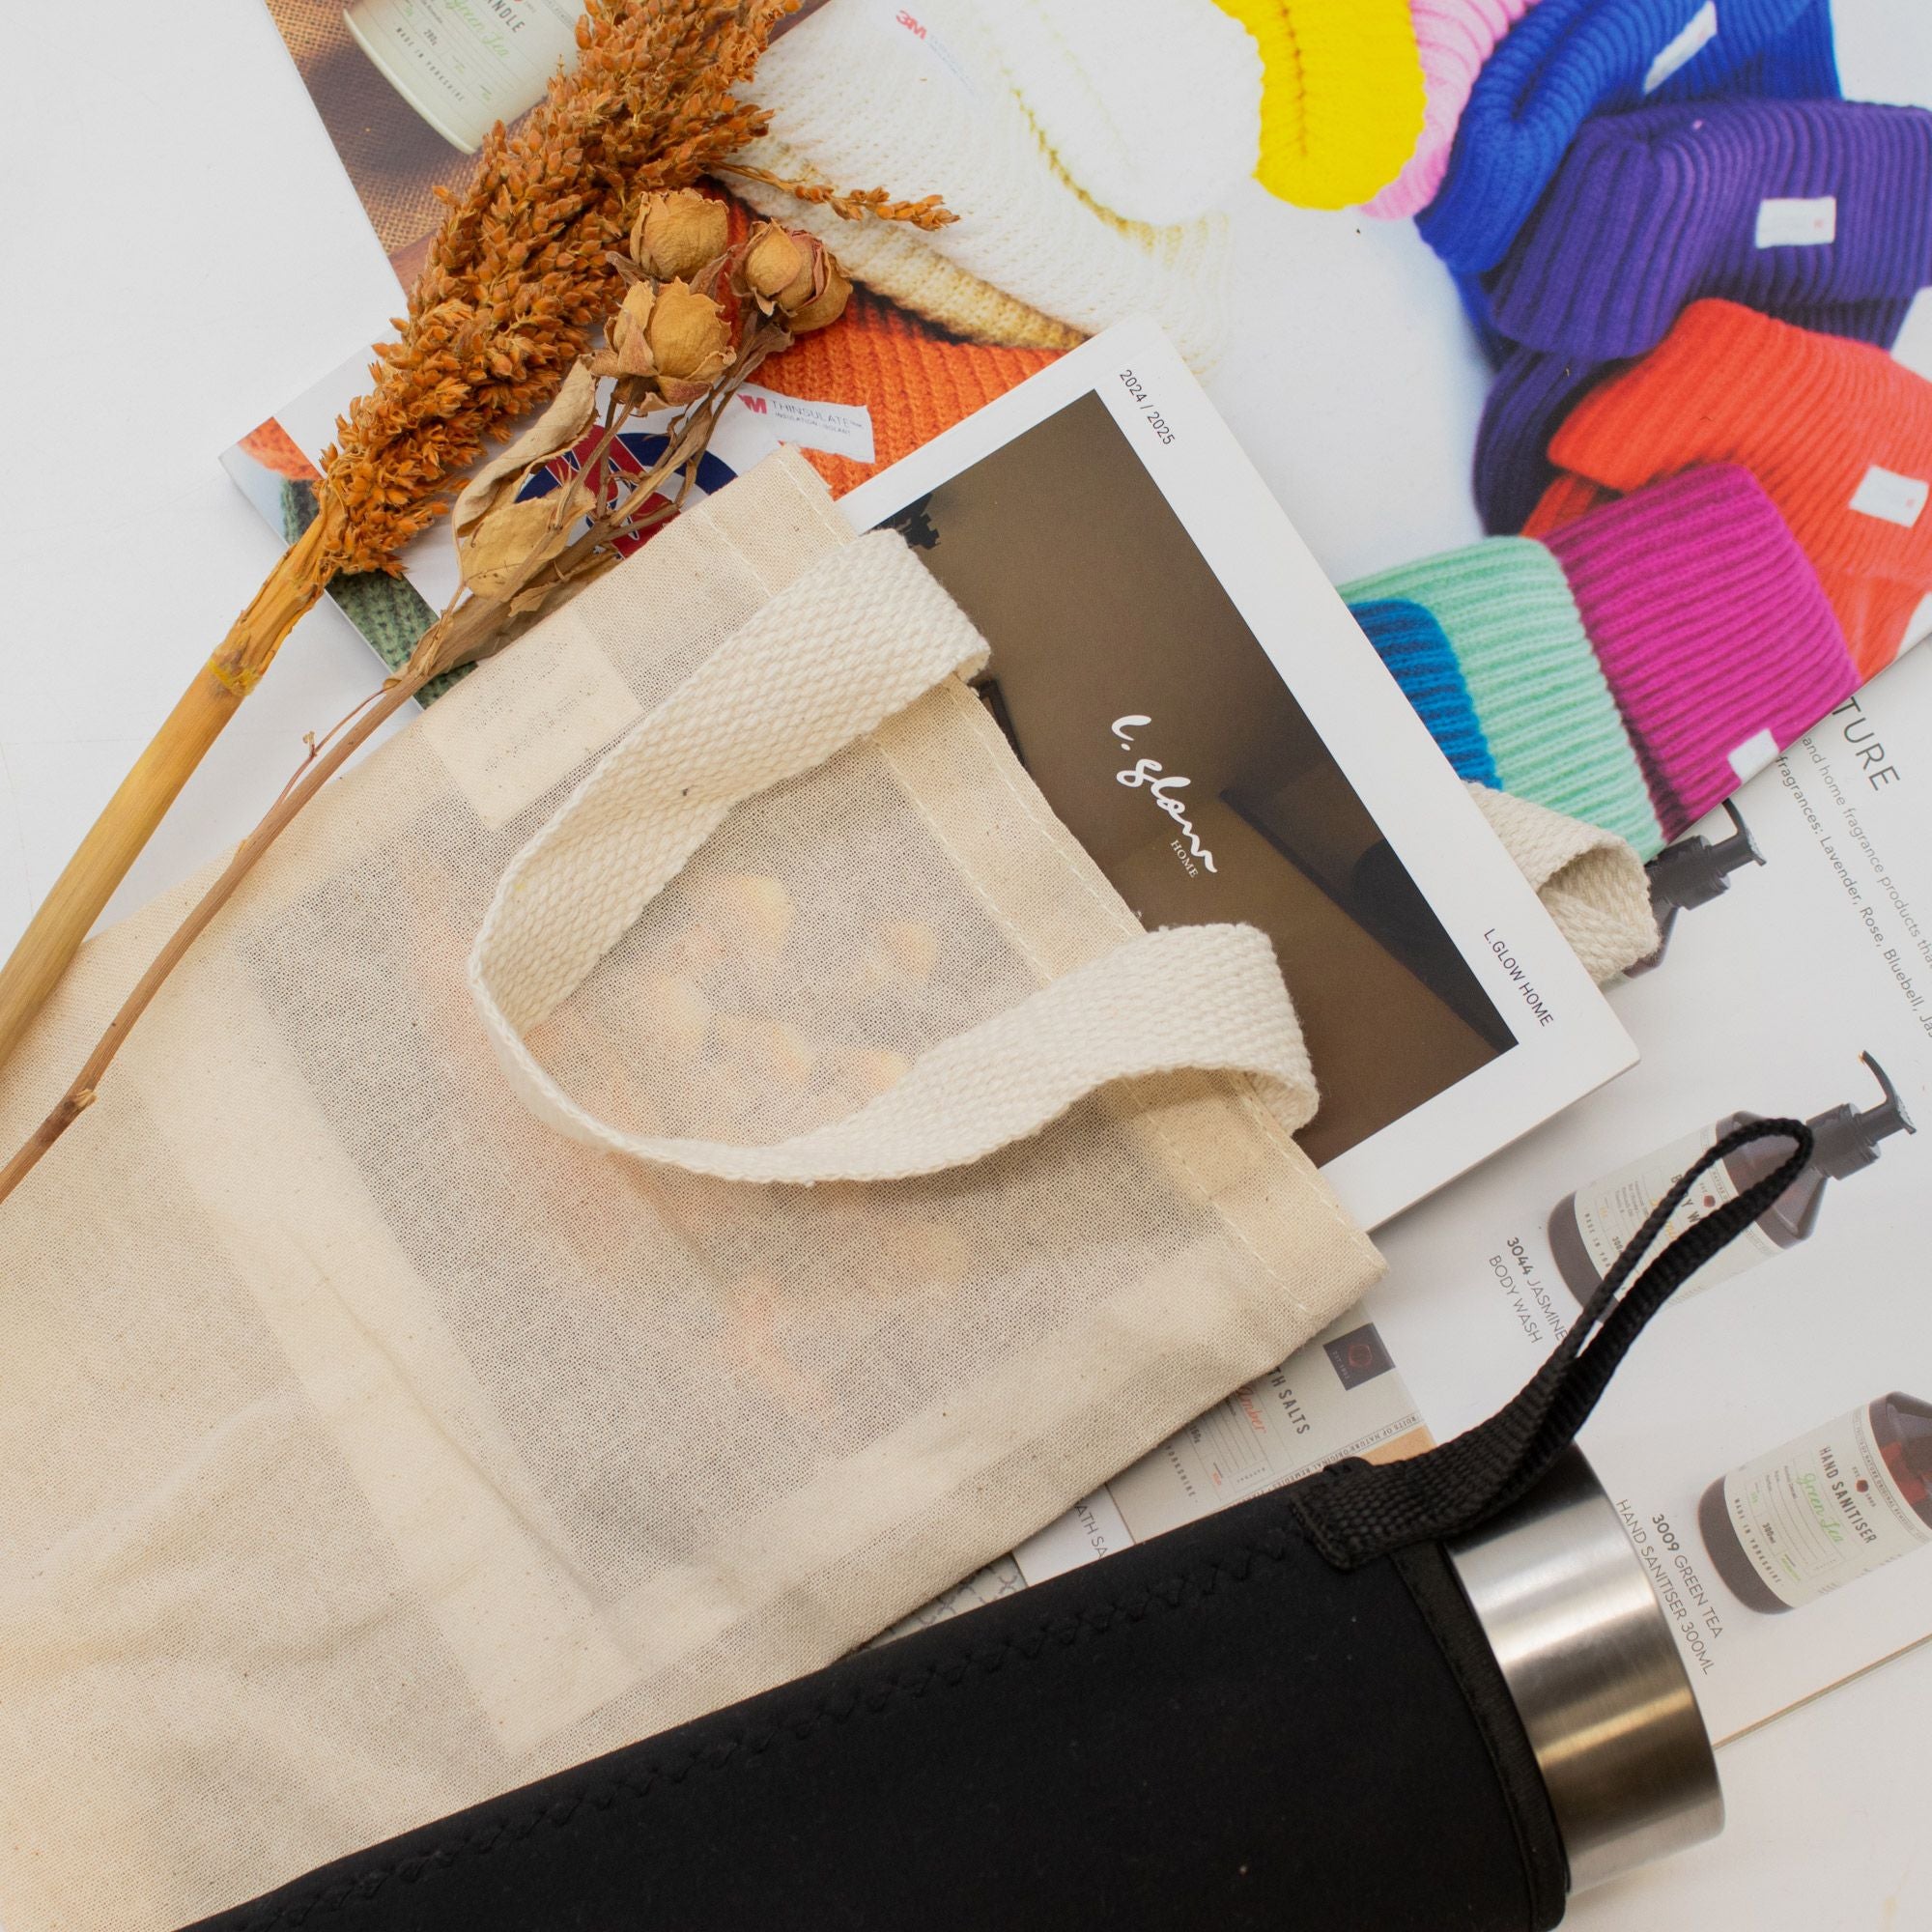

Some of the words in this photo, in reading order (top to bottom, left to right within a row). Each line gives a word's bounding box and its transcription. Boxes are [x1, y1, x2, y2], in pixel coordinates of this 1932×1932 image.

[486, 0, 525, 33] NDLE
[1120, 369, 1148, 403] 2024
[1147, 411, 1175, 445] 2025
[1170, 839, 1199, 878] HOME
[1774, 753, 1825, 835] fragrances:
[1819, 836, 1861, 903] Lavender,
[1860, 905, 1886, 947] Rose,
[1883, 948, 1924, 1011] Bluebell,
[1801, 736, 1825, 764] and
[1817, 763, 1845, 807] home
[1842, 806, 1885, 873] fragrance
[1877, 874, 1921, 938] products
[1917, 939, 1932, 969] tha
[1484, 928, 1525, 981] L.GLOW
[1519, 982, 1553, 1027] HOME
[1489, 1254, 1519, 1294] BODY
[1512, 1297, 1542, 1342] WASH
[1506, 1236, 1534, 1275] 3044
[1526, 1276, 1568, 1340] JASMINE
[1277, 1388, 1310, 1435] SALTS
[1072, 1502, 1096, 1534] ATH
[1798, 1472, 1825, 1515] Green
[1819, 1518, 1844, 1544] Tea
[1818, 1445, 1838, 1479] HAND
[1831, 1480, 1876, 1544] SANITISER
[1615, 1499, 1648, 1544] HAND
[1640, 1545, 1688, 1620] SANITISER
[1680, 1620, 1714, 1674] 300ML
[1651, 1512, 1680, 1552] 3009
[1672, 1553, 1708, 1606] GREEN
[1701, 1606, 1722, 1638] TEA
[1749, 1538, 1781, 1582] YORKSHIRE
